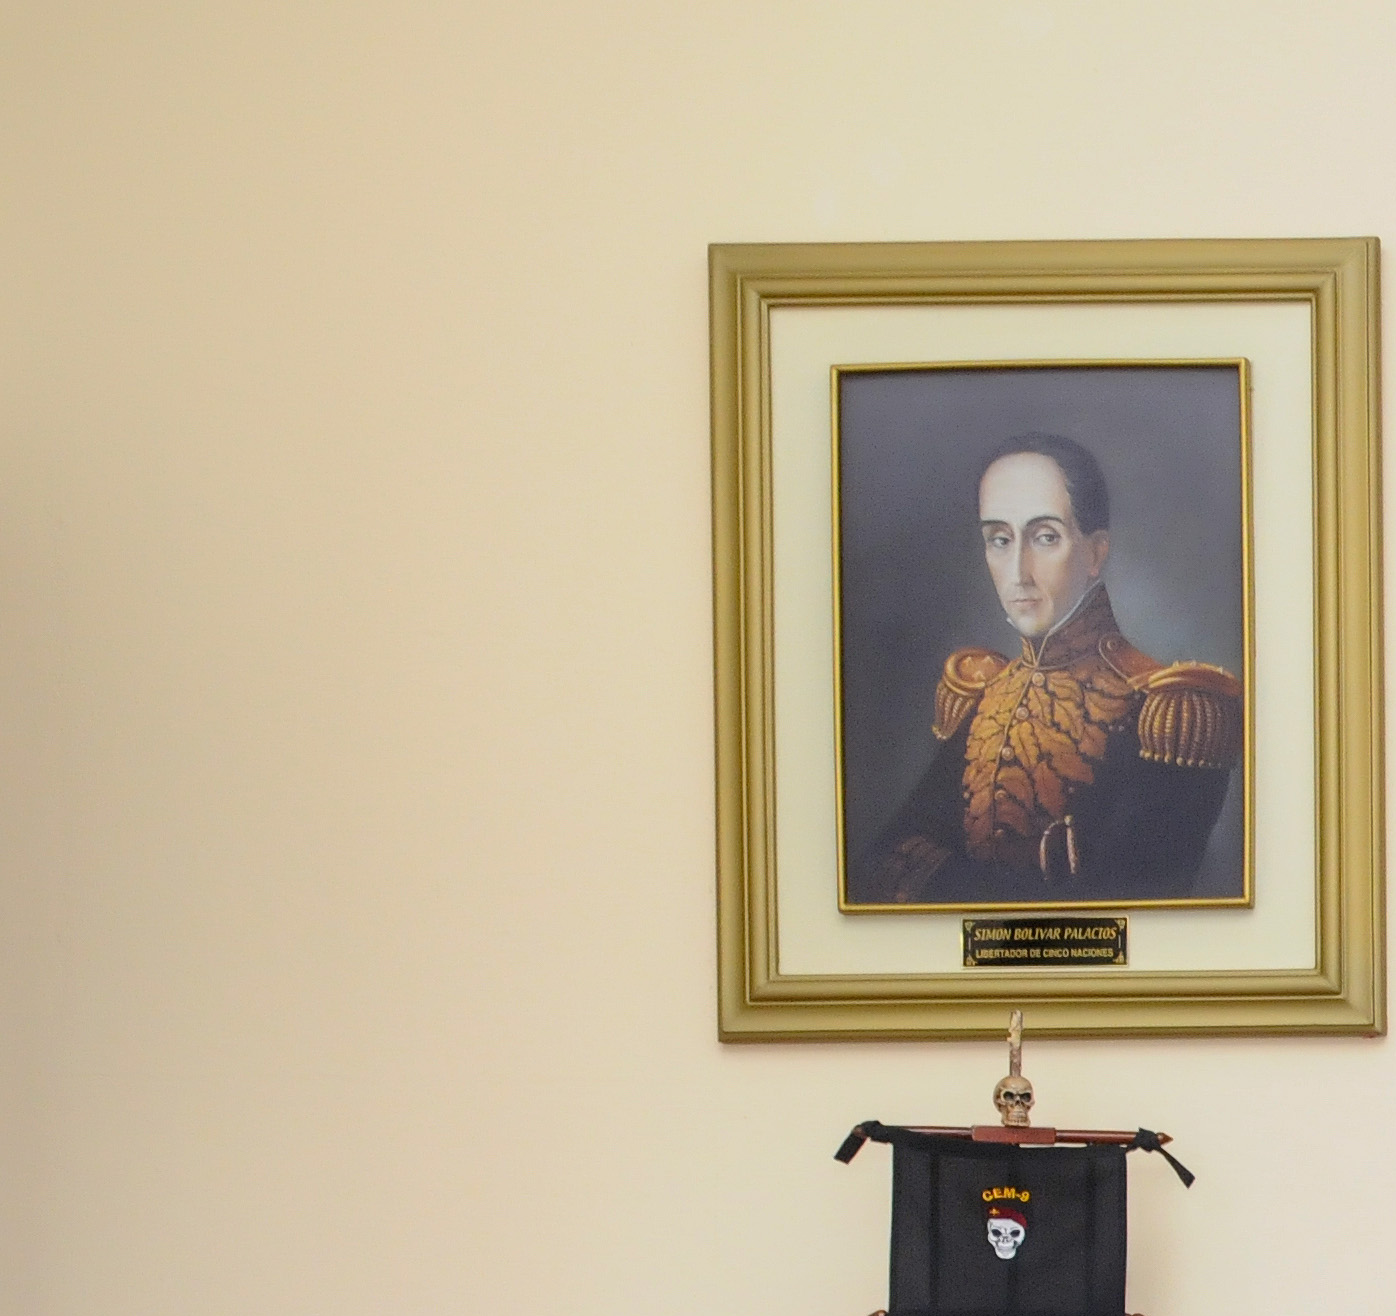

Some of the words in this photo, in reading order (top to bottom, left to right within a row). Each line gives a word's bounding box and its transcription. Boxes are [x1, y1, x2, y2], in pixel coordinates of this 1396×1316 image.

[1014, 927, 1061, 940] BOLIVAR
[1064, 926, 1117, 940] PALACIOS
[975, 948, 1028, 958] LIBERTADOR
[1030, 948, 1041, 958] DE
[1043, 947, 1069, 958] CINCO
[1071, 947, 1113, 957] NACIONES
[982, 1187, 1030, 1202] CEM-9
